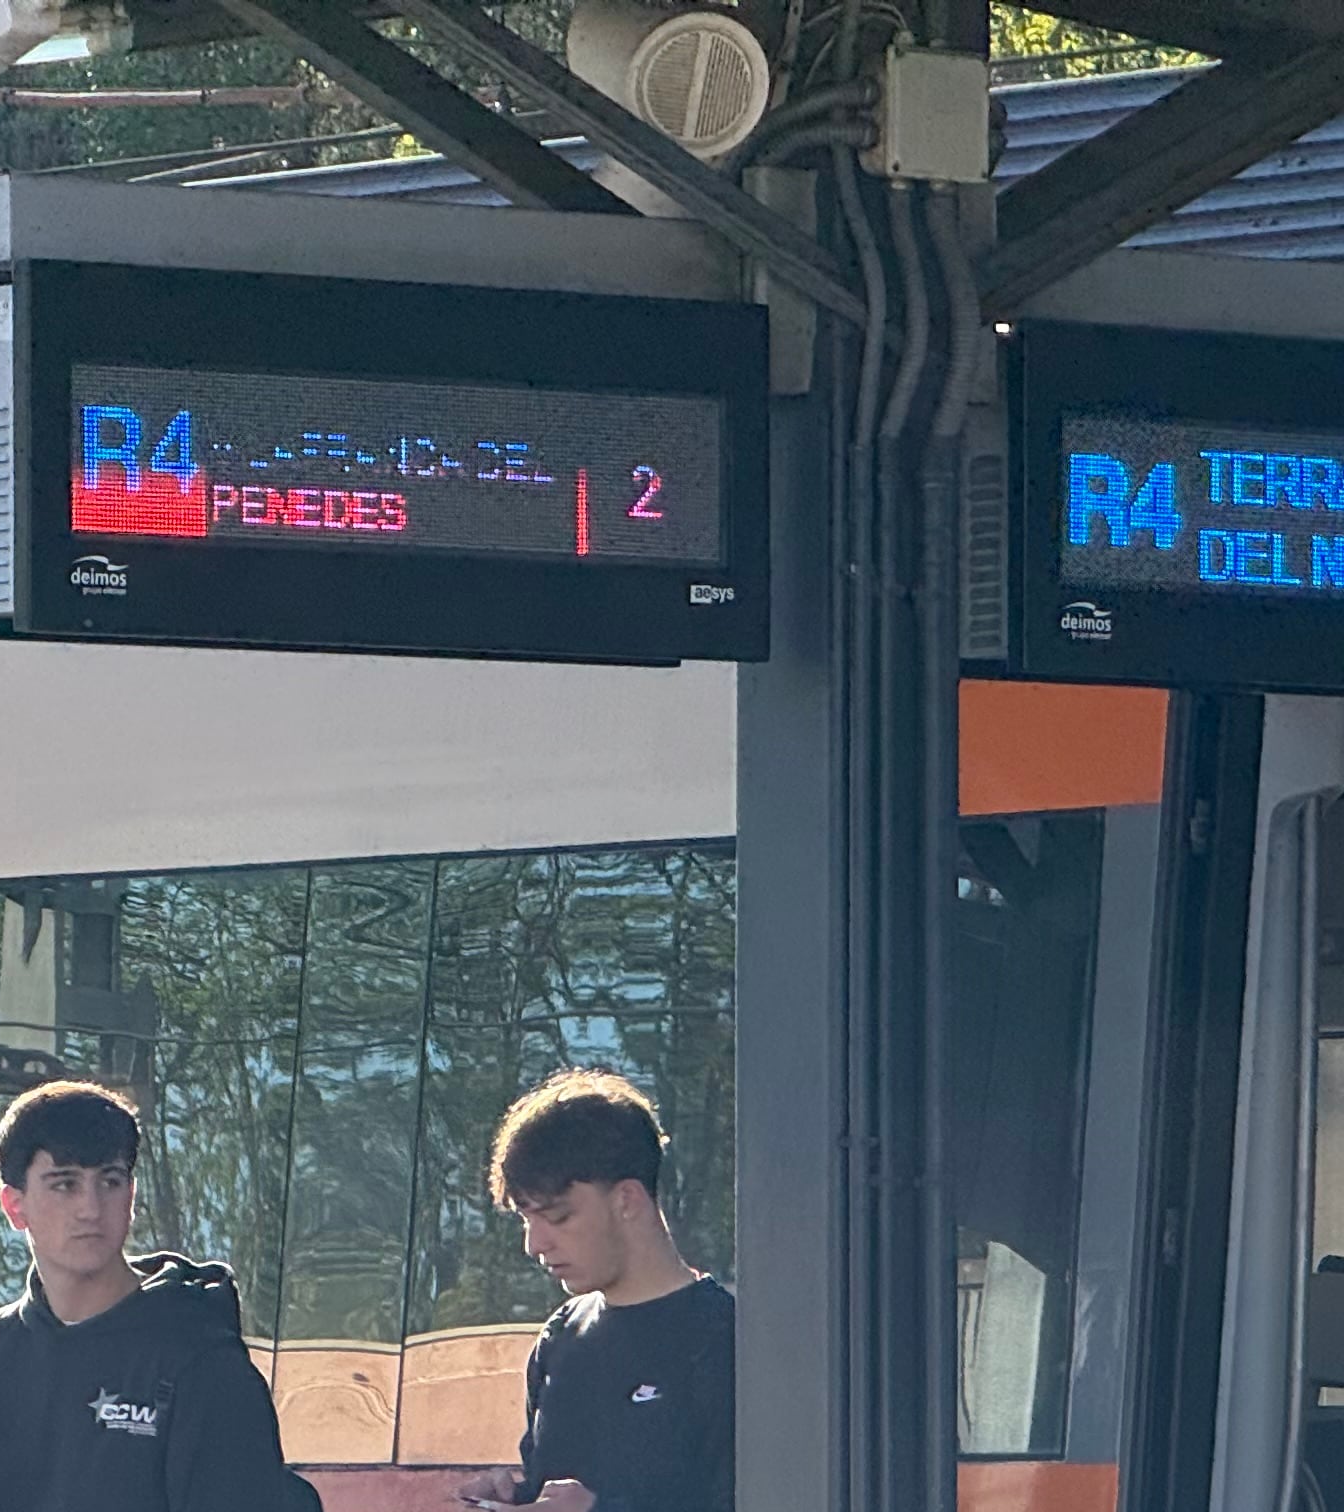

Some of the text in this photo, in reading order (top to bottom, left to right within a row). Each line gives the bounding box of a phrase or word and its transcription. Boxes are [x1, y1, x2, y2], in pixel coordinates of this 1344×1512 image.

[83, 405, 200, 494] R4
[213, 485, 406, 530] PENEDES
[628, 465, 662, 517] 2
[1068, 453, 1181, 548] R4
[70, 566, 127, 587] deimos
[1199, 528, 1302, 585] DEL
[690, 585, 735, 604] aesys
[1060, 612, 1112, 632] deimos
